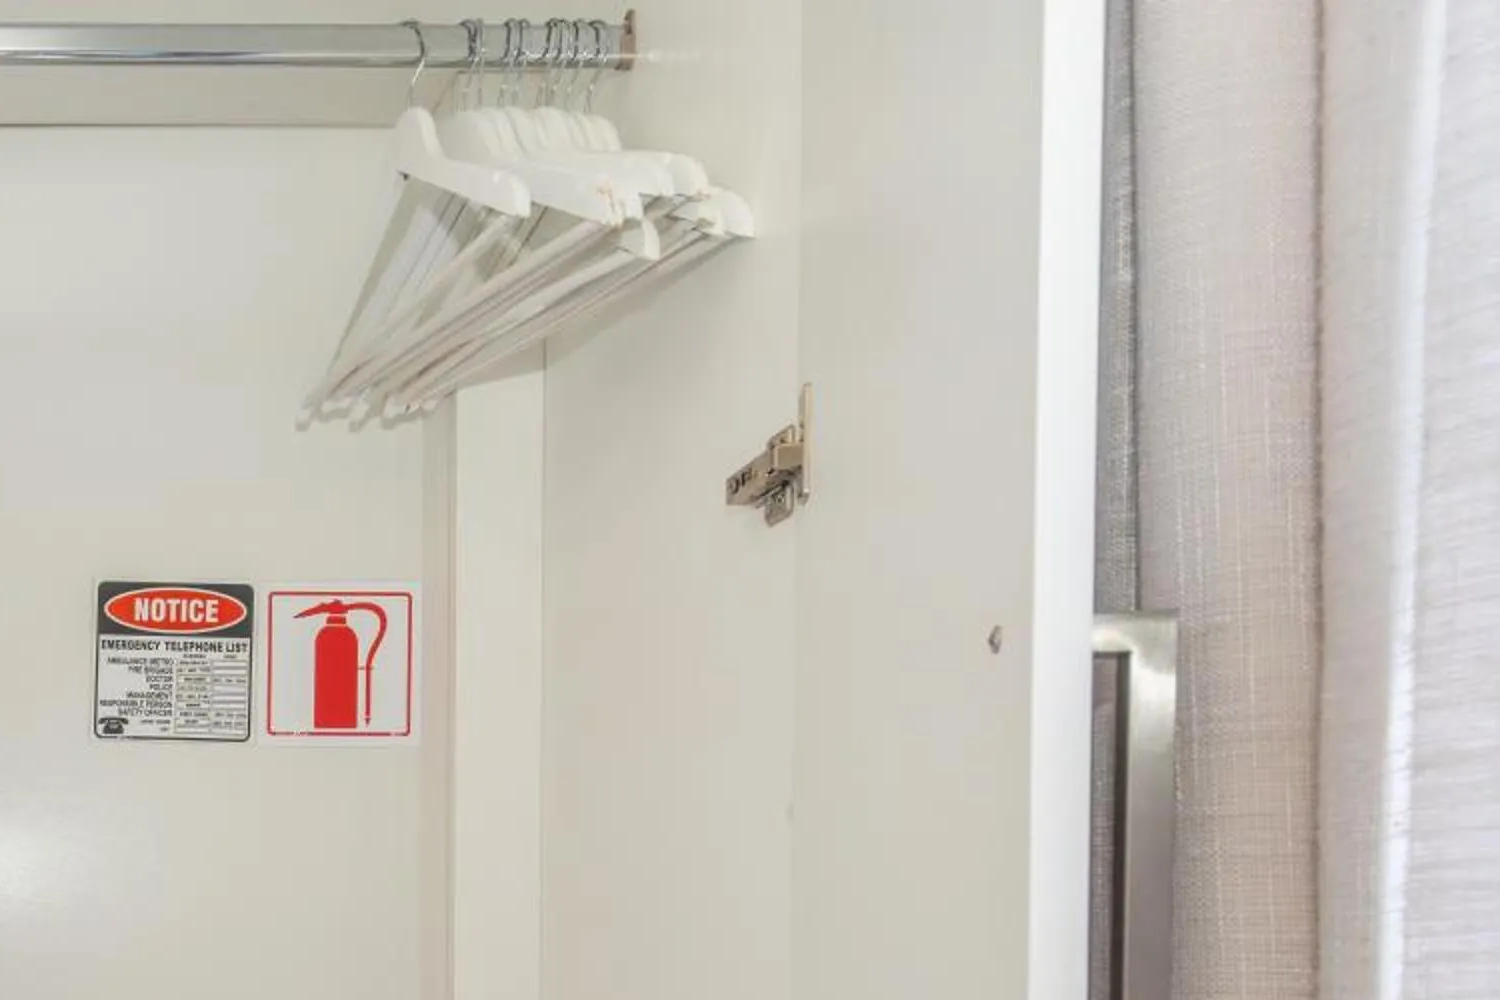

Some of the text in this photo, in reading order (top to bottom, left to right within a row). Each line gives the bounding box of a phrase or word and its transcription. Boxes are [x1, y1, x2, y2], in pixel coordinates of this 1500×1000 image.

[133, 597, 220, 623] NOTICE
[101, 639, 248, 653] EMERGENCY TELEPHONE LIST
[146, 675, 173, 683] DOCTOR
